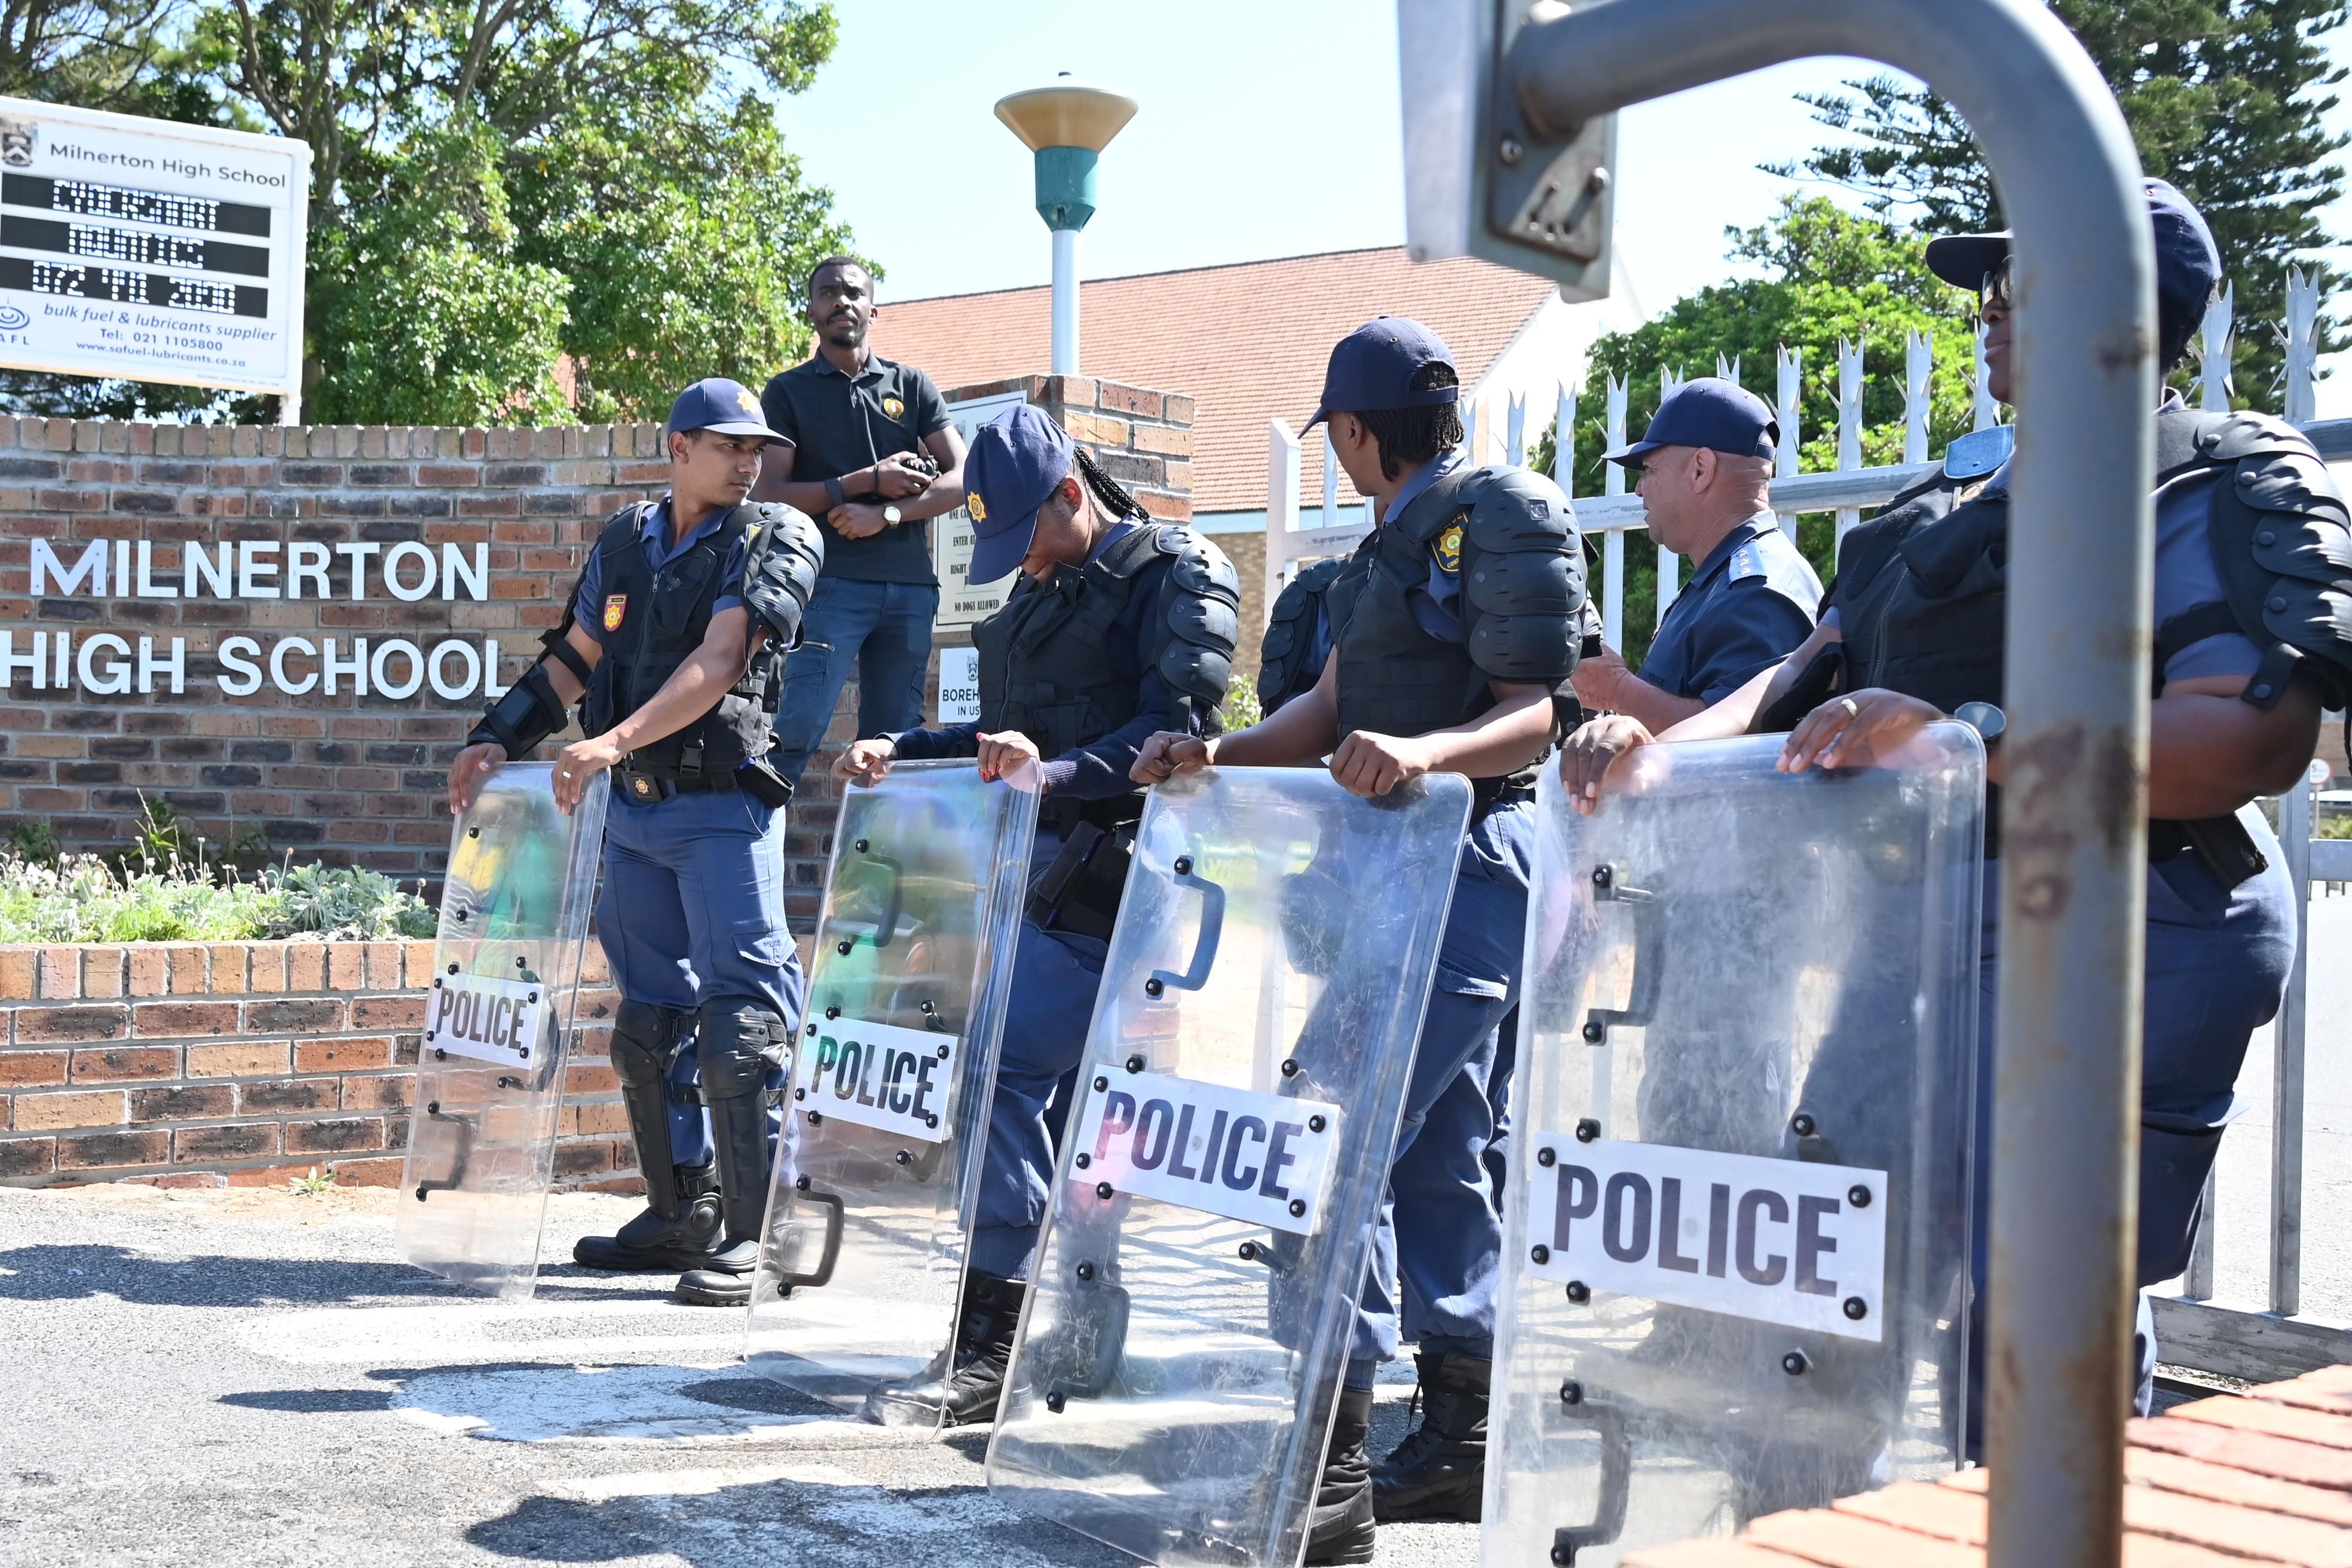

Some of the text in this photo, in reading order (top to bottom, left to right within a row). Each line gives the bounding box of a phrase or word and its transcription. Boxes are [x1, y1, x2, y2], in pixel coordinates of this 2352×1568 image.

[51, 143, 286, 188] Milnerton High School
[32, 260, 85, 296] 072
[44, 303, 277, 341] bulk fuel & lubricants supplier
[100, 329, 223, 351] Tel: 021 1105800
[76, 342, 246, 368] www.safuel-lubricants.co.za
[953, 535, 968, 547] ENTER
[30, 538, 489, 602] MILNERTON
[950, 564, 967, 574] RIGHT
[954, 599, 1000, 612] NO DOGS ALLOWED
[0, 630, 514, 700] HIGH SCHOOL
[942, 688, 979, 702] BOREH
[957, 706, 980, 716] IN US
[436, 987, 528, 1051] POLICE
[811, 1035, 939, 1120] POLICE
[1094, 1090, 1304, 1201] POLICE
[1553, 1163, 1840, 1297] POLICE
